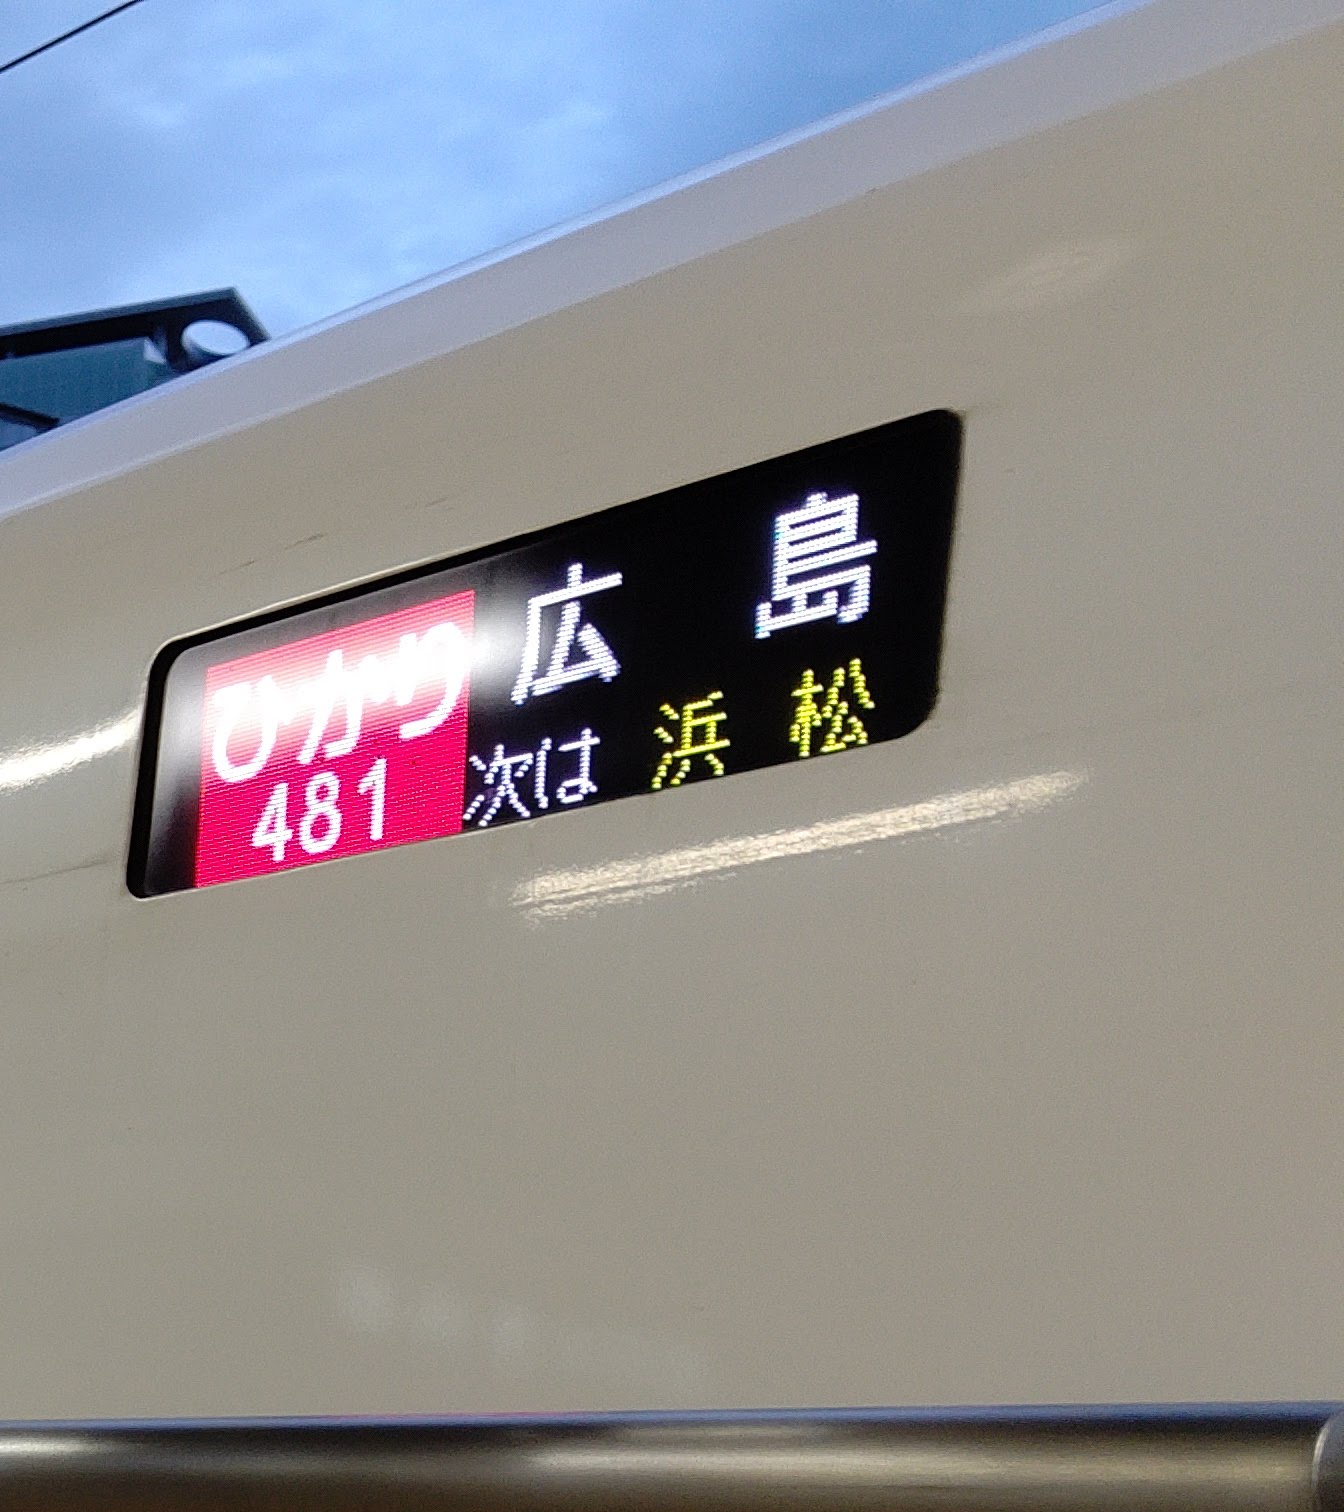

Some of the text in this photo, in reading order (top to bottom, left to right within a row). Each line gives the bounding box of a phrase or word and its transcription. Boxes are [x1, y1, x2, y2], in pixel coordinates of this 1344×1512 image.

[511, 491, 879, 705] 広島
[212, 621, 466, 784] ひかり
[462, 656, 875, 827] 次は 浜松
[252, 757, 388, 863] 481
